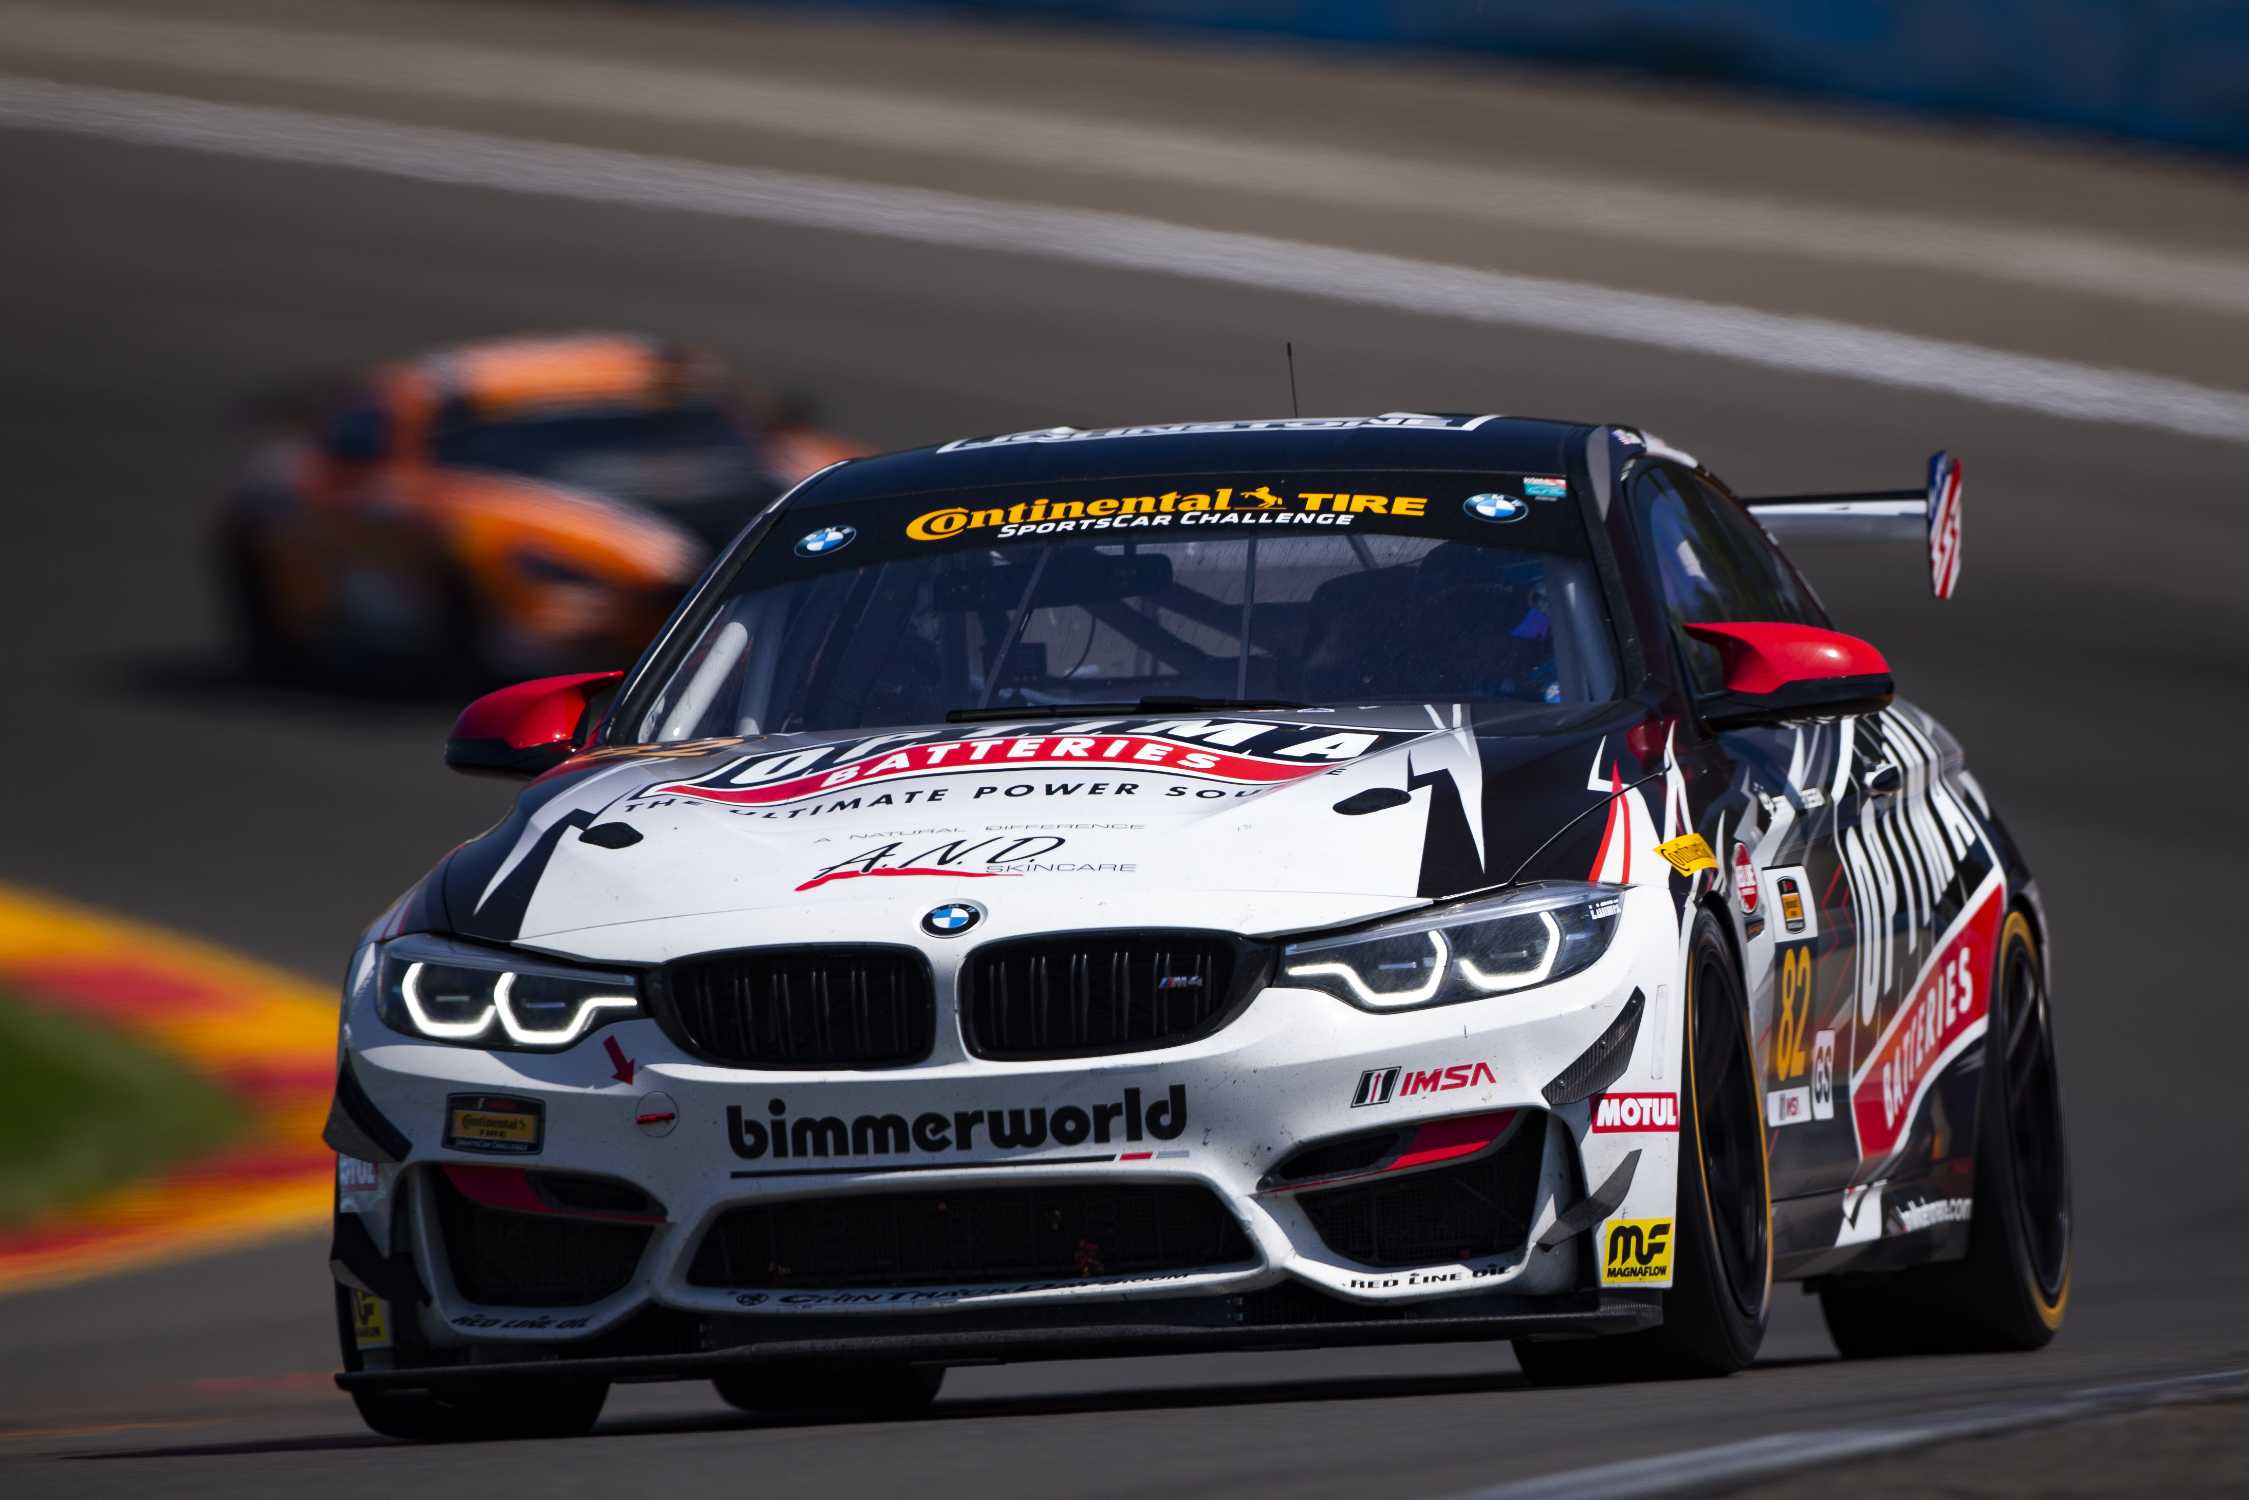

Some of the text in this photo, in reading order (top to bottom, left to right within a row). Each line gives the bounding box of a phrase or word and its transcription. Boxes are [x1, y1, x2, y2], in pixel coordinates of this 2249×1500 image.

[906, 488, 1428, 541] Continental TIRE
[822, 738, 1216, 786] BATTERIES
[730, 789, 949, 819] ULTIMATE
[974, 782, 1139, 799] POWER
[986, 862, 1137, 873] SKINCARE
[1777, 945, 1811, 1082] 82
[1882, 946, 1973, 1131] BATTERIES
[1400, 1062, 1496, 1096] IMSA
[726, 1084, 1187, 1159] bimmerworld
[1597, 1098, 1677, 1126] MOTUL
[1607, 1265, 1668, 1279] MAGNAFLOW
